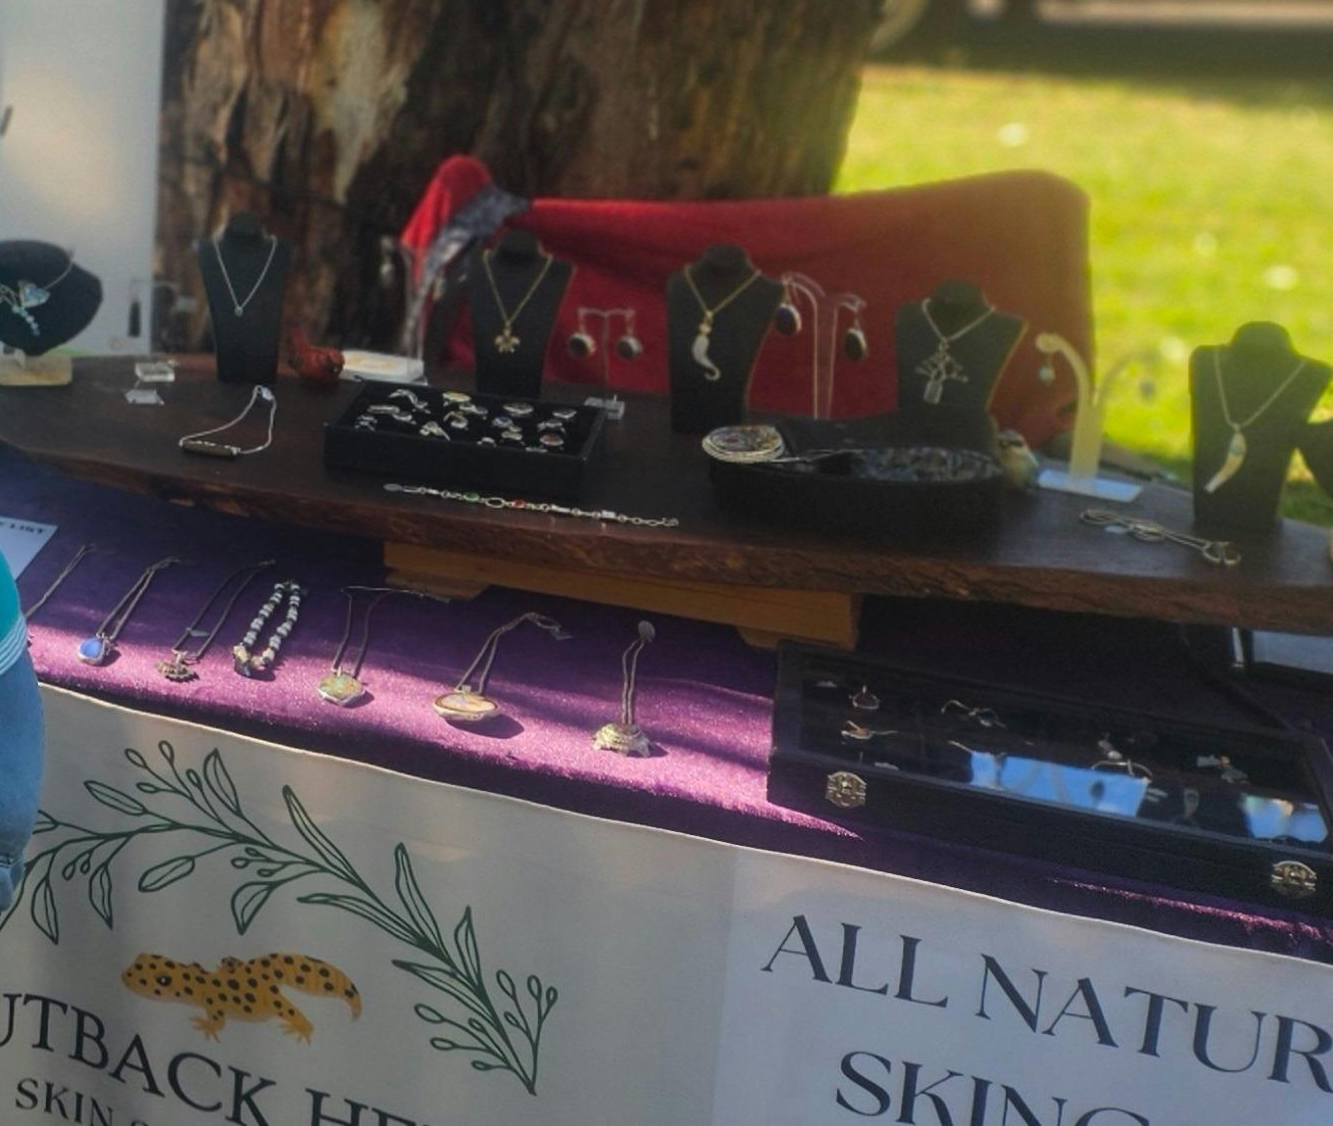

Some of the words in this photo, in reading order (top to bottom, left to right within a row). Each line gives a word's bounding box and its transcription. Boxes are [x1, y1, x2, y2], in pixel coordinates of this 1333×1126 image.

[760, 914, 949, 1008] ALL
[974, 952, 1333, 1093] NATUR
[14, 1077, 114, 1126] SKIN
[836, 1050, 1151, 1126] SKIN
